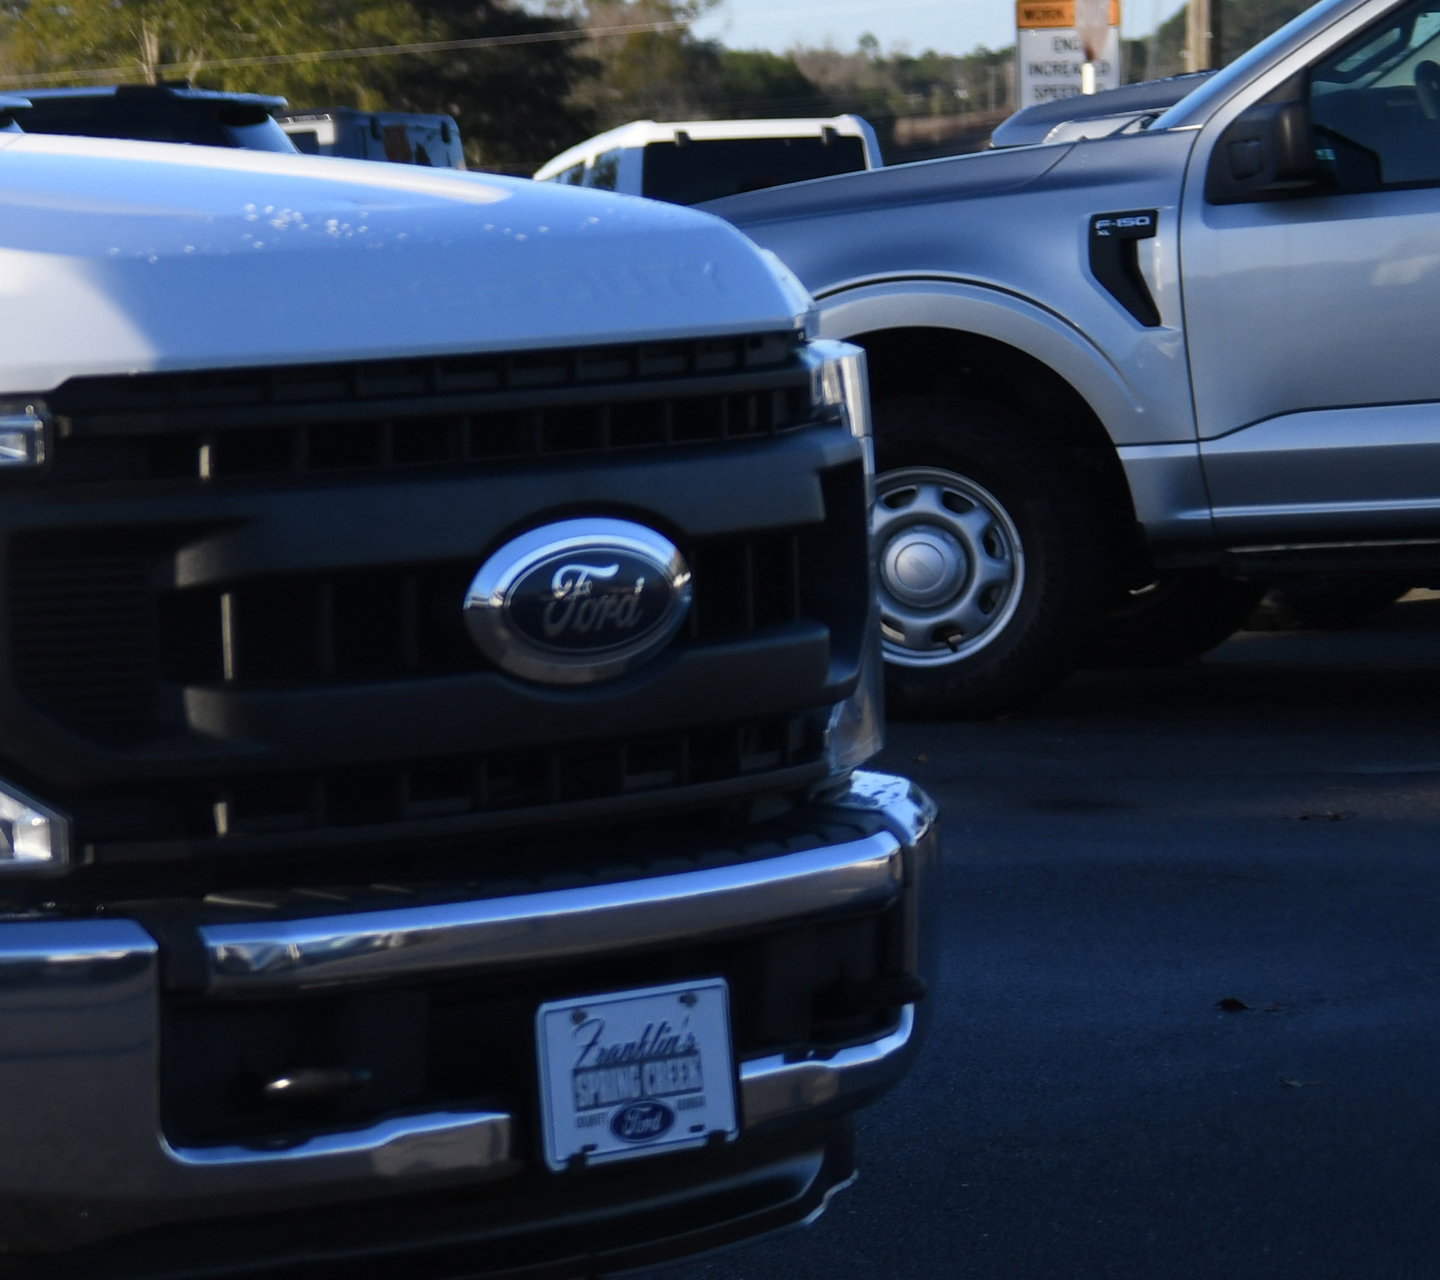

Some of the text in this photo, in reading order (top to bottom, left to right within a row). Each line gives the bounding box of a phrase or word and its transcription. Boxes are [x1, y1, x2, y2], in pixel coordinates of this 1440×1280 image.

[1095, 216, 1150, 230] F-150
[542, 563, 646, 638] Ford
[572, 1015, 698, 1070] Franklin's
